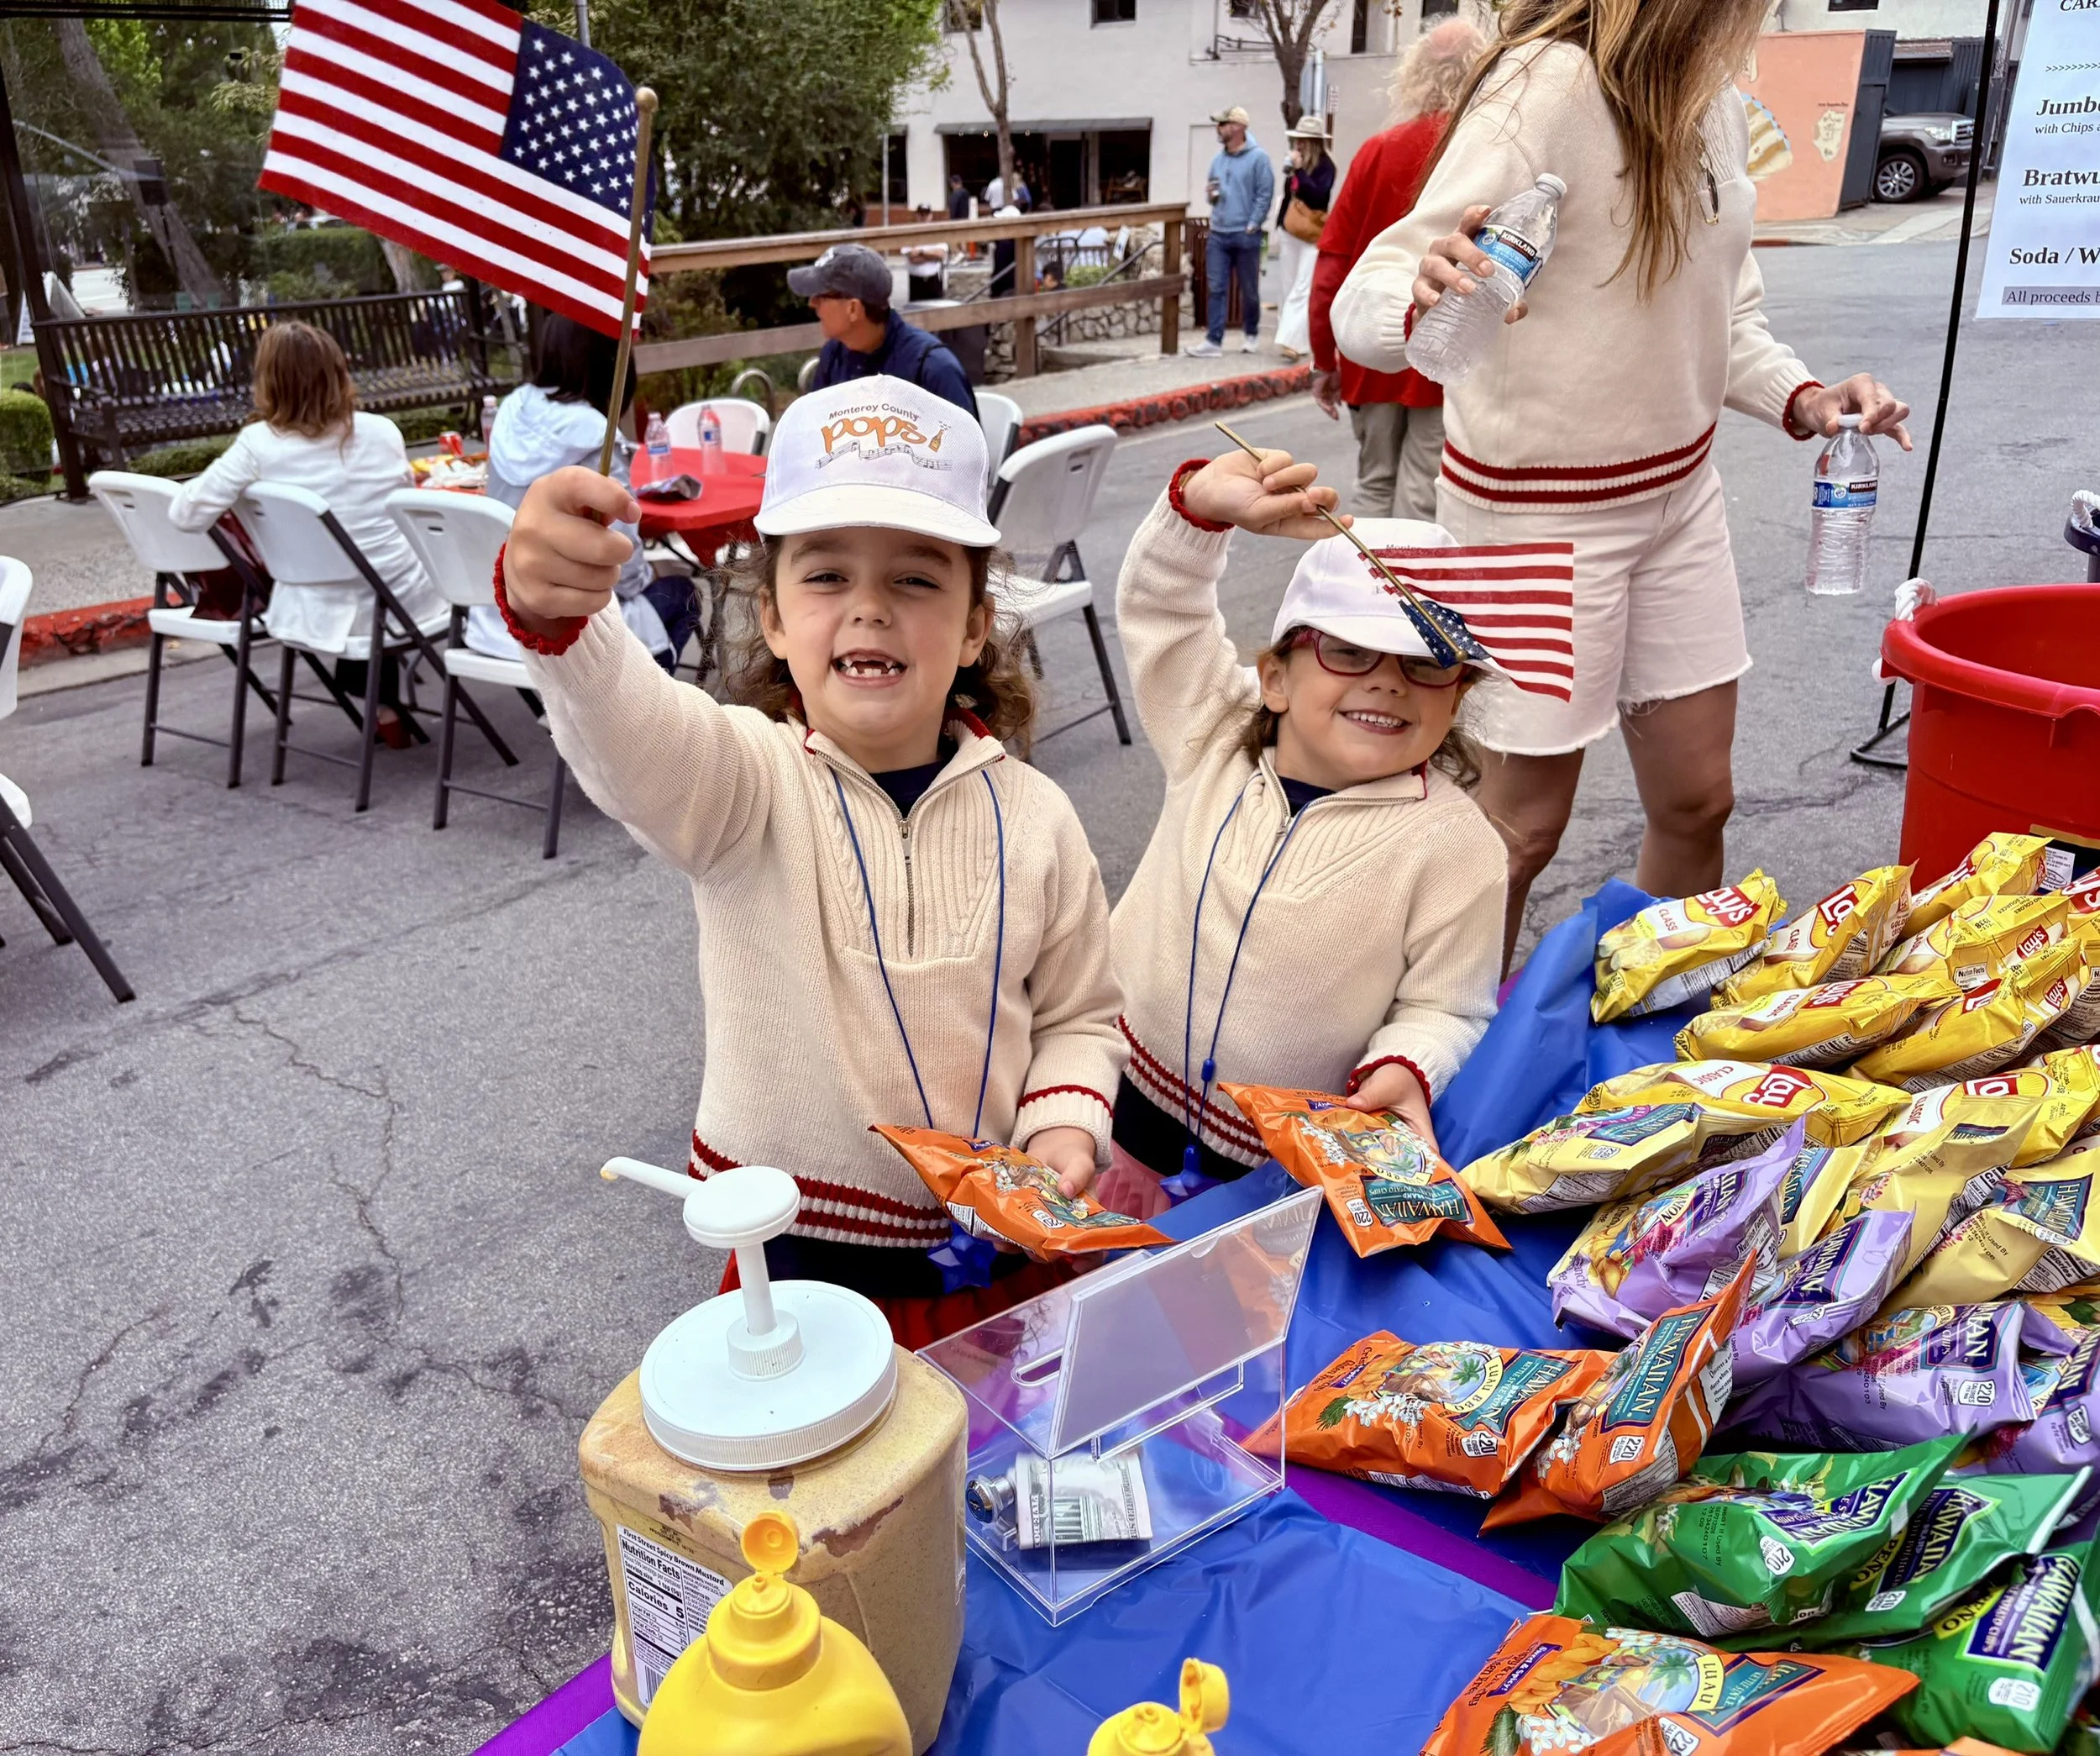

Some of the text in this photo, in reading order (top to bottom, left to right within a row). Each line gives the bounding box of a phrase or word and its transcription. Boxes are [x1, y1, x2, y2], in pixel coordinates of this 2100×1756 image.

[2034, 124, 2058, 134] with
[2061, 123, 2094, 134] Chips
[2019, 194, 2042, 205] with
[1501, 232, 1536, 257] KIRKLAND
[2009, 247, 2059, 265] Soda
[2065, 247, 2075, 264] /
[2006, 291, 2027, 303] All
[2030, 291, 2091, 306] proceeds
[828, 403, 921, 421] Monterey County
[821, 416, 927, 454] pops
[2013, 900, 2035, 914] COLORS
[2019, 929, 2045, 956] Lay's
[2045, 981, 2065, 1007] Lay's
[1698, 1065, 1734, 1085] CLASSIC
[1907, 1096, 1927, 1125] CLASSIC
[1369, 1187, 1388, 1196] CHIPS
[1355, 1211, 1372, 1223] 220
[1374, 1198, 1460, 1218] HAWAIIAN
[1738, 1226, 1756, 1254] Nutrition
[1987, 1236, 2002, 1250] Used
[2000, 1247, 2009, 1257] By
[1801, 1227, 1851, 1292] HAWAIIAN
[2046, 1249, 2073, 1279] Calories
[1942, 1329, 1952, 1355] CHIPS
[1630, 1317, 1698, 1414] HAWAIIAN
[1733, 1352, 1739, 1361] By
[1515, 1361, 1534, 1380] KETTLE
[1454, 1364, 1499, 1412] LUAU BBQ
[1479, 1364, 1563, 1424] HAWAN
[1969, 1383, 1978, 1403] CALORIES
[1977, 1383, 1992, 1404] 220
[1879, 1401, 1887, 1411] By
[1478, 1432, 1496, 1454] 220
[1620, 1438, 1641, 1459] 220
[1702, 1506, 1715, 1560] 26134240107
[1916, 1524, 1930, 1554] BRAND
[622, 1540, 656, 1566] Nutrition
[657, 1559, 681, 1580] Facts
[623, 1528, 637, 1540] First
[638, 1538, 656, 1552] Street
[656, 1548, 674, 1561] Spicy
[674, 1556, 695, 1571] Brown
[695, 1566, 725, 1586] Mustard
[1715, 1556, 1722, 1566] By
[1767, 1547, 1791, 1571] 210
[625, 1560, 643, 1577] Serving
[628, 1580, 669, 1611] Calories
[675, 1606, 685, 1619] 5
[2007, 1557, 2079, 1664] HAWAIIAN
[632, 1610, 648, 1624] Sodium
[634, 1626, 650, 1639] Protein
[1525, 1645, 1547, 1664] Sweet
[1501, 1669, 1525, 1691] Spicy!
[1698, 1661, 1718, 1704] LUAU
[2013, 1684, 2036, 1706] 210
